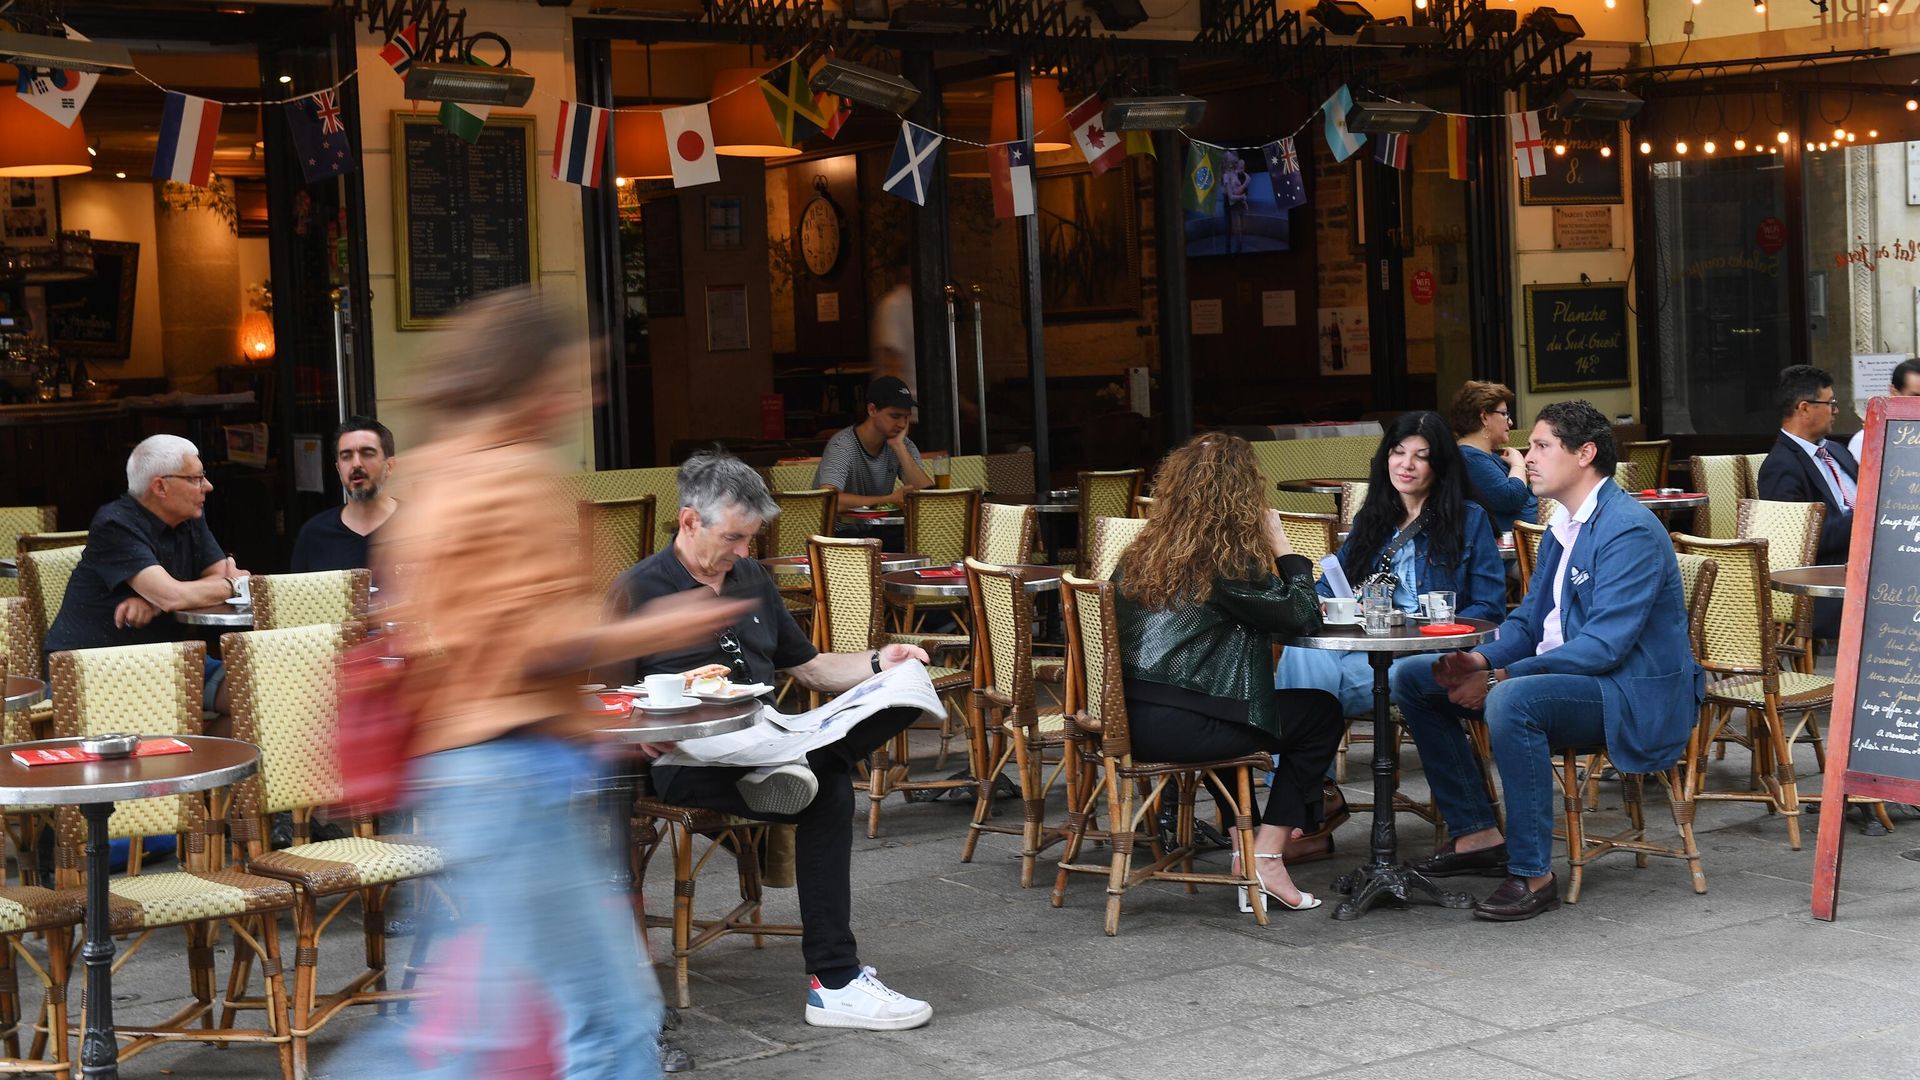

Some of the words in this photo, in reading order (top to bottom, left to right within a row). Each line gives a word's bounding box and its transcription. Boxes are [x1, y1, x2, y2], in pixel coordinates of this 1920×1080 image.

[1553, 301, 1608, 323] Planche
[1546, 334, 1563, 351] du
[1872, 583, 1904, 602] Petit
